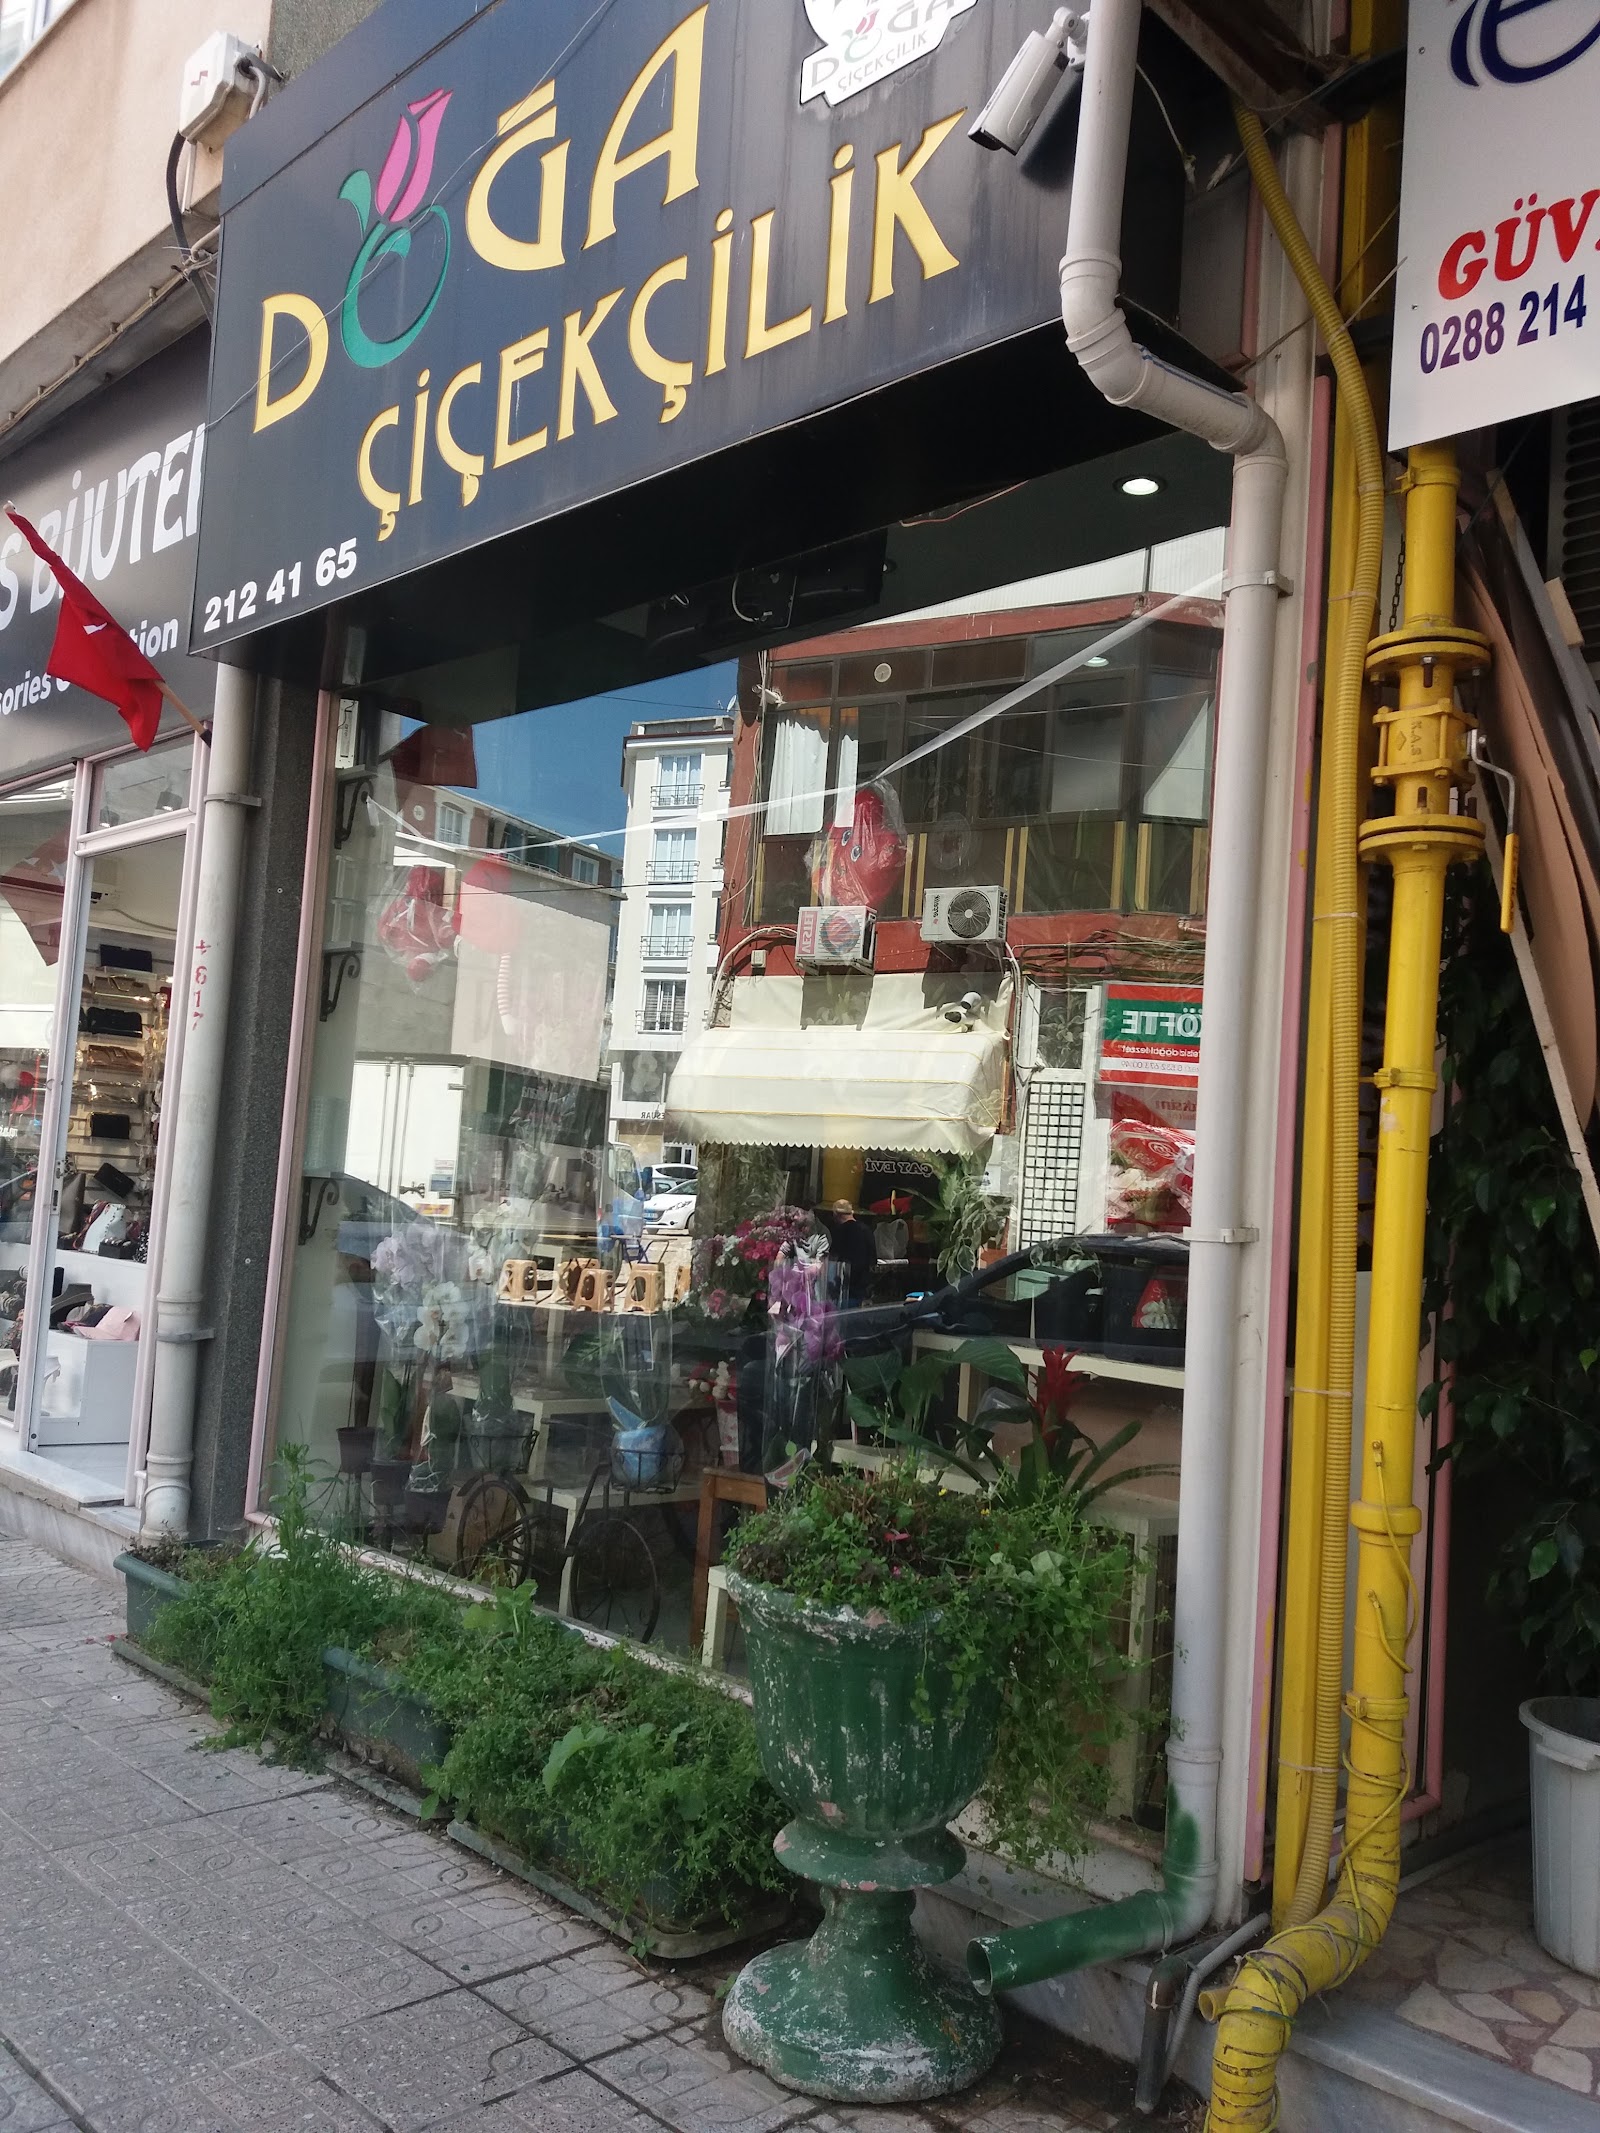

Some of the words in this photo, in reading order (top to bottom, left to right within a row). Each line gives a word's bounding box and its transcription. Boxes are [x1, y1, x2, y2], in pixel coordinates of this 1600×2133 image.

[1437, 188, 1600, 301] GÜV
[357, 107, 968, 542] ÇİÇEKÇİLİK
[1419, 301, 1506, 375] 0288
[1516, 273, 1588, 347] 214
[203, 580, 258, 634] 212
[266, 561, 302, 605] 41
[315, 537, 357, 587] 65
